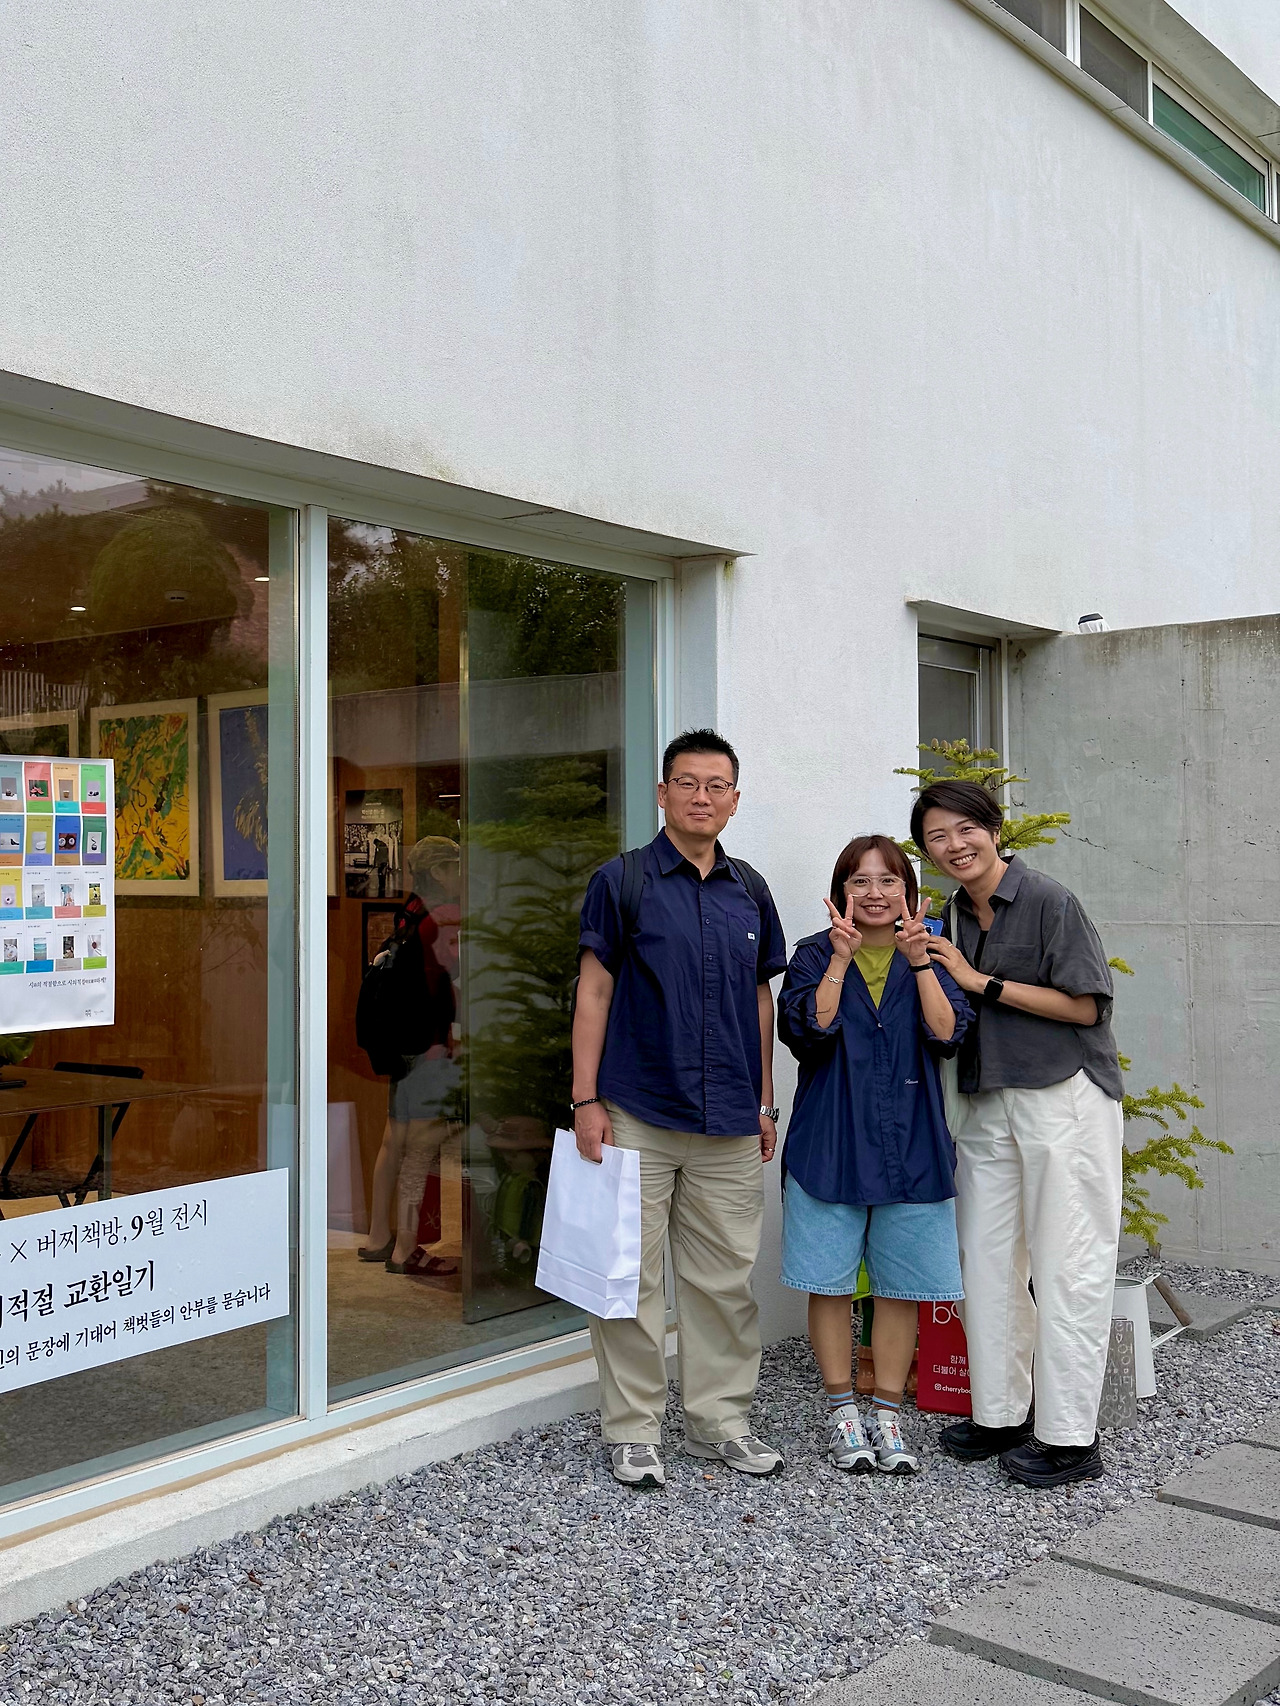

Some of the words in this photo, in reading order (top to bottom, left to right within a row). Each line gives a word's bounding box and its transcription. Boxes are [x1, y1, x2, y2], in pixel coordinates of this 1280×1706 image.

[170, 1199, 208, 1232] 전시
[0, 1283, 55, 1330] 적절
[63, 1260, 155, 1309] 교환일기
[25, 1333, 70, 1362] 문장에
[74, 1320, 117, 1348] 기대어
[122, 1305, 175, 1335] 책벗들의
[179, 1296, 219, 1321] 안부를
[221, 1282, 271, 1311] 묻습니다
[932, 1364, 957, 1376] 더불어
[950, 1354, 966, 1365] 함께
